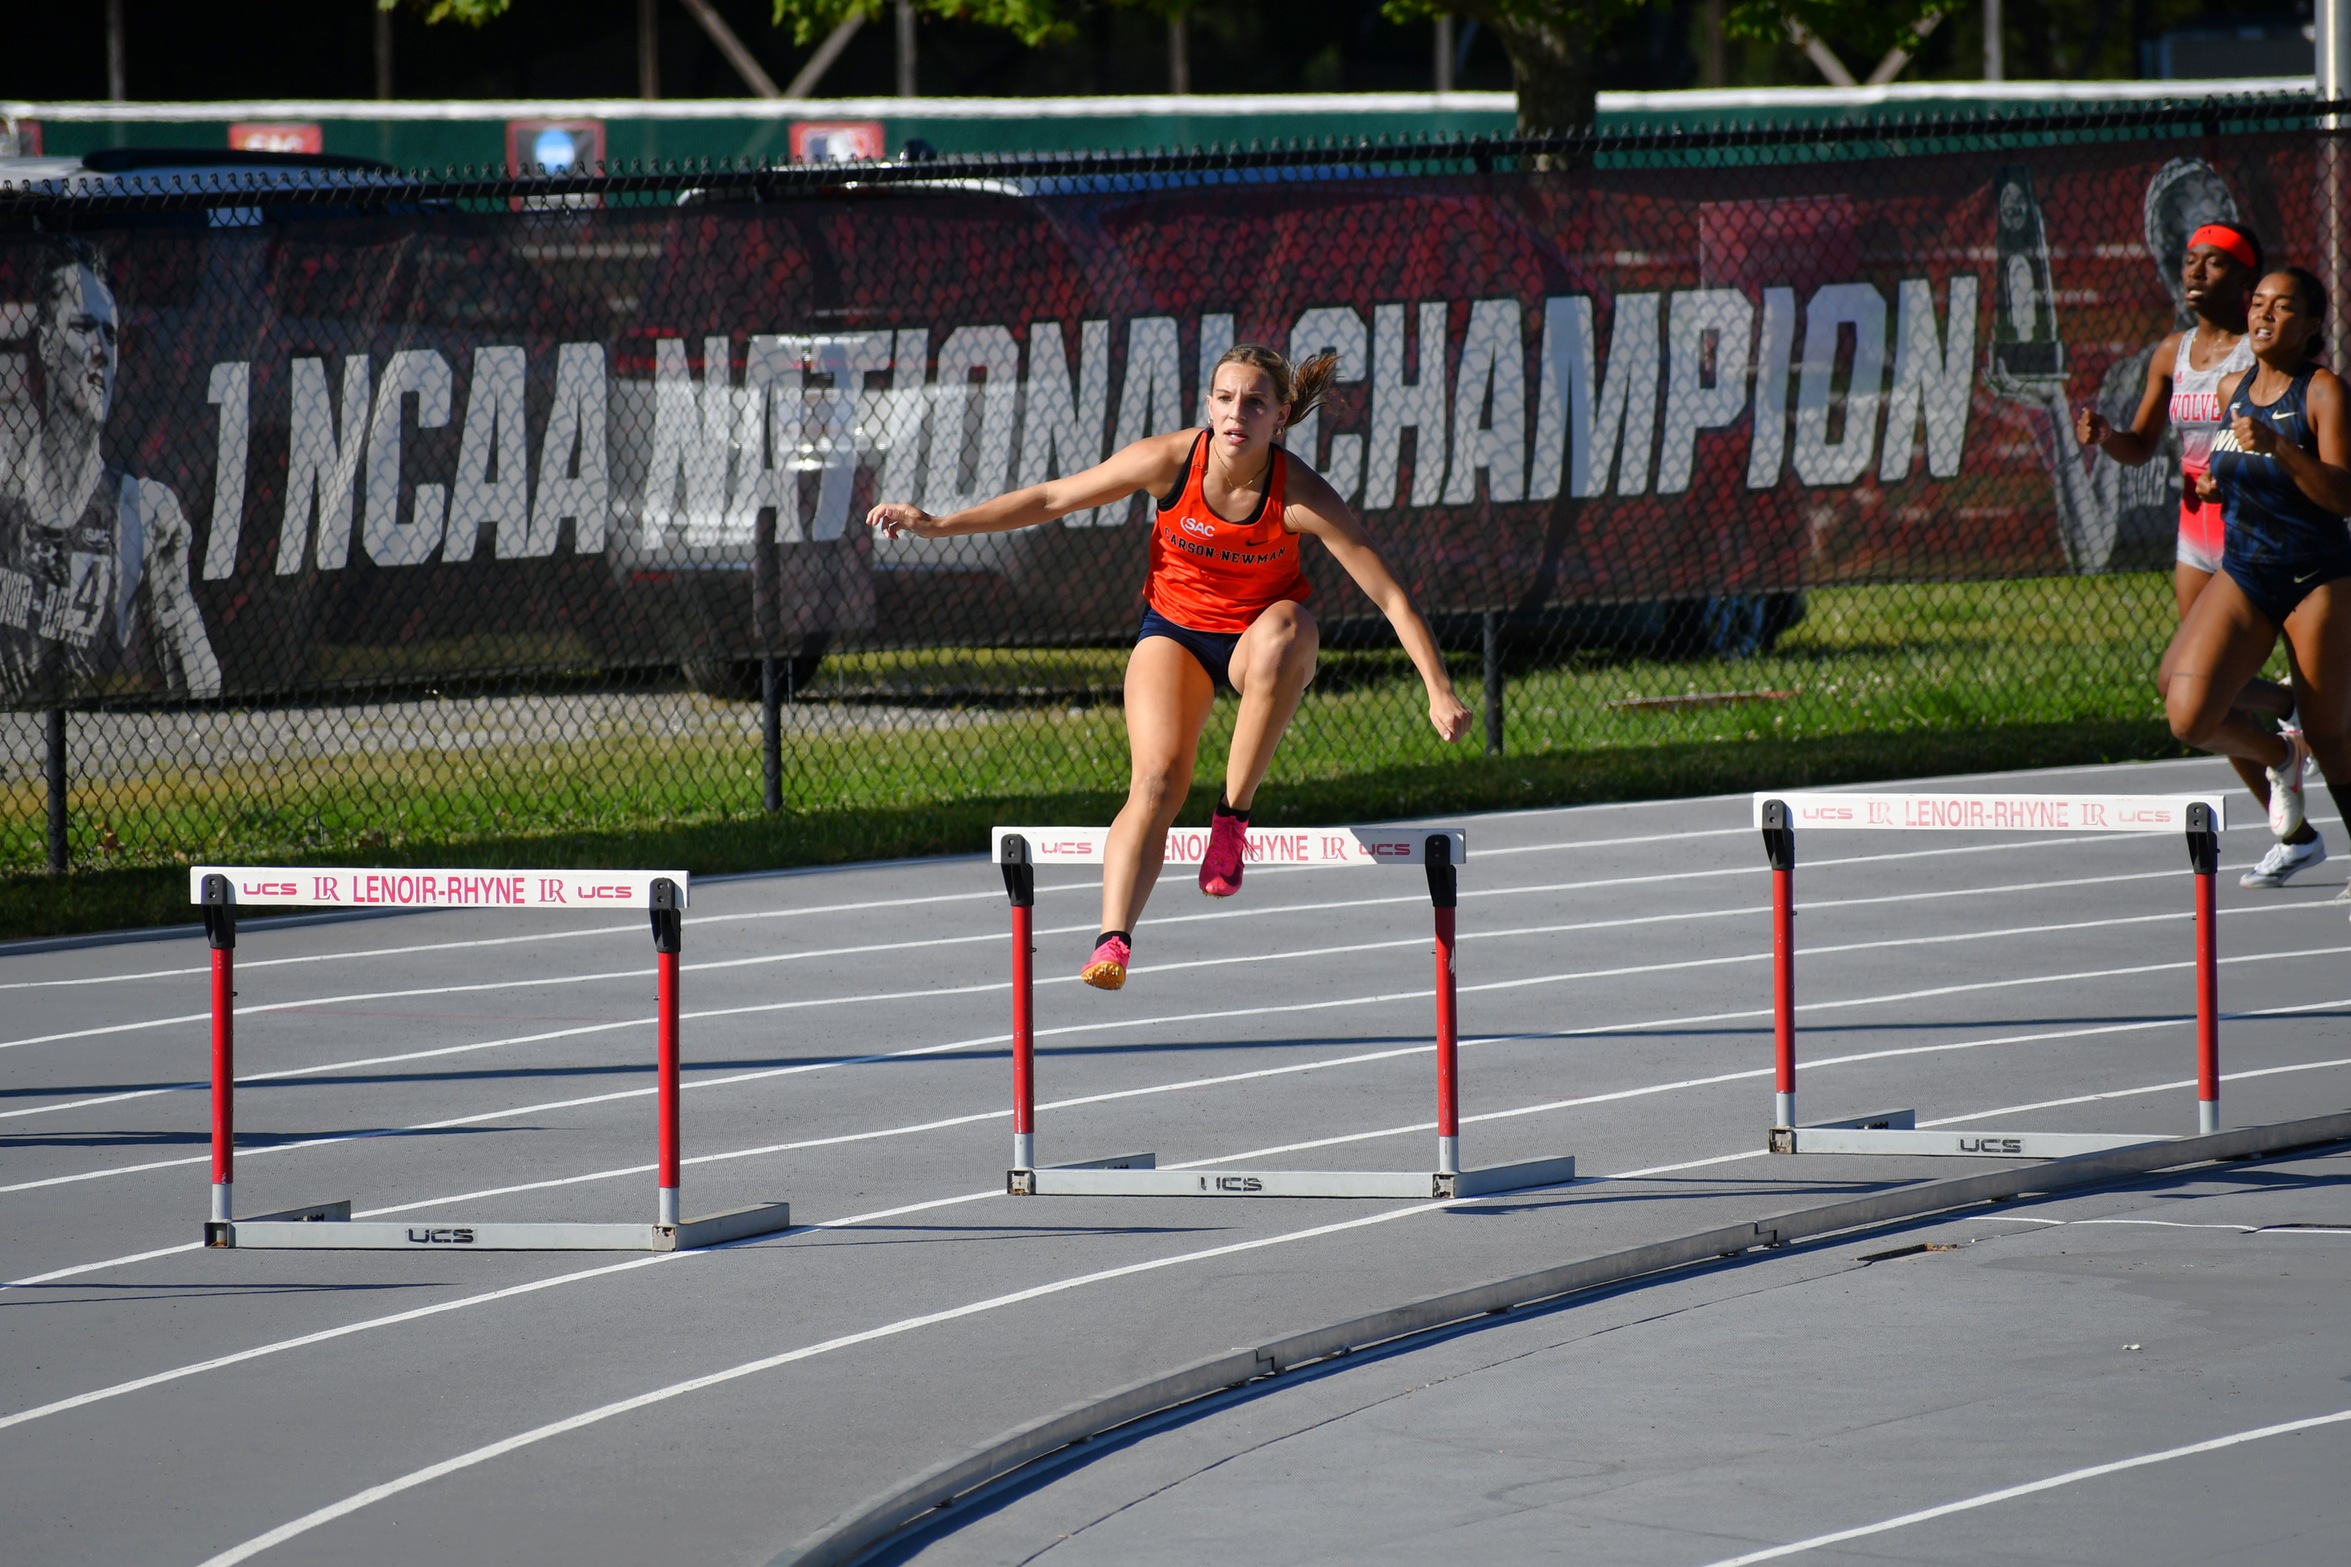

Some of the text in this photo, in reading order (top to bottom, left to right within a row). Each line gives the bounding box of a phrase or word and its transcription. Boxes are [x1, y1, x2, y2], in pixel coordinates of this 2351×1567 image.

[2169, 393, 2222, 422] WOLVE
[203, 360, 250, 580] 1
[275, 341, 608, 576] NCAA
[1285, 275, 1978, 510] CHAMPION
[1183, 516, 1216, 538] SAC
[1164, 527, 1287, 565] CARSON-NEWMAN
[1803, 800, 2172, 828] UCS LR LENOIR-RHYNE LR UCS
[1041, 842, 1093, 854] UCS
[1320, 836, 1349, 861] LR
[1358, 843, 1411, 856] UCS
[243, 875, 633, 904] UCS LR LENOIR-RHYNE LR UCS
[1960, 1138, 2022, 1154] UCS
[408, 1228, 474, 1243] UCS
